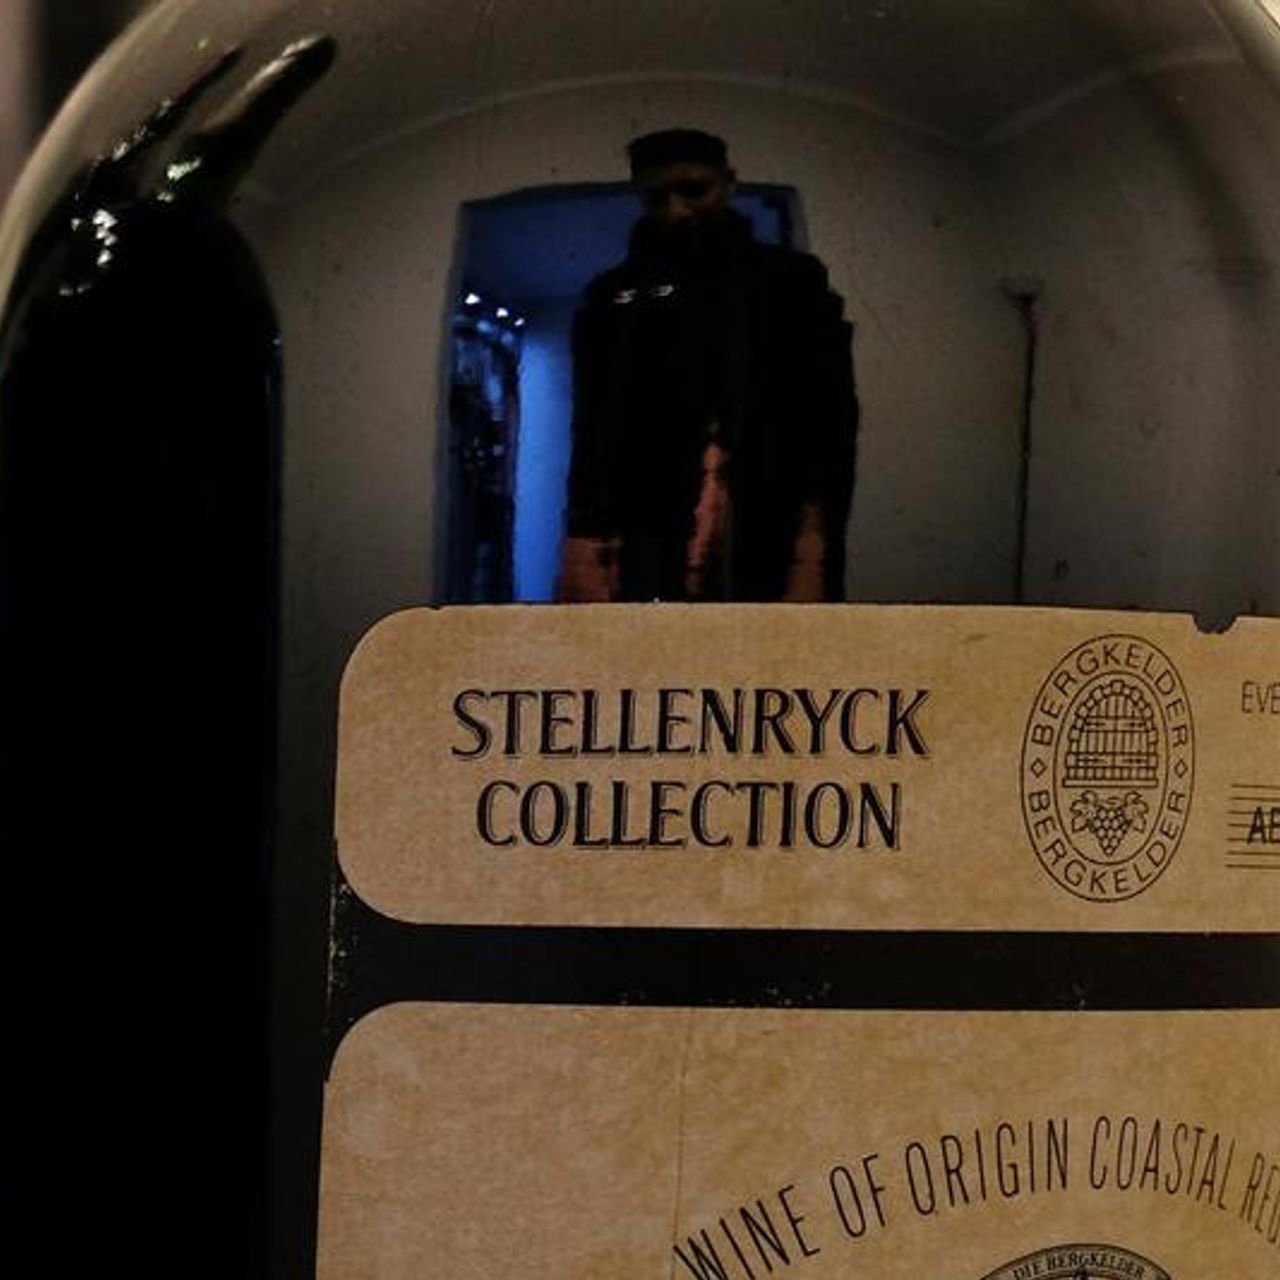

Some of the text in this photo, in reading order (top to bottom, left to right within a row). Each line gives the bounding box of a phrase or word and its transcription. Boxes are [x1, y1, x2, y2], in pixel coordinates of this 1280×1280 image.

[449, 687, 935, 761] STELLENRYCK
[1031, 643, 1189, 748] BERGKELDER
[474, 779, 903, 851] COLLECTION
[1027, 789, 1188, 895] BERGKELDER
[829, 1153, 887, 1238] OF
[904, 1117, 1070, 1216] ORIGIN
[1090, 1115, 1237, 1211] COASTAL
